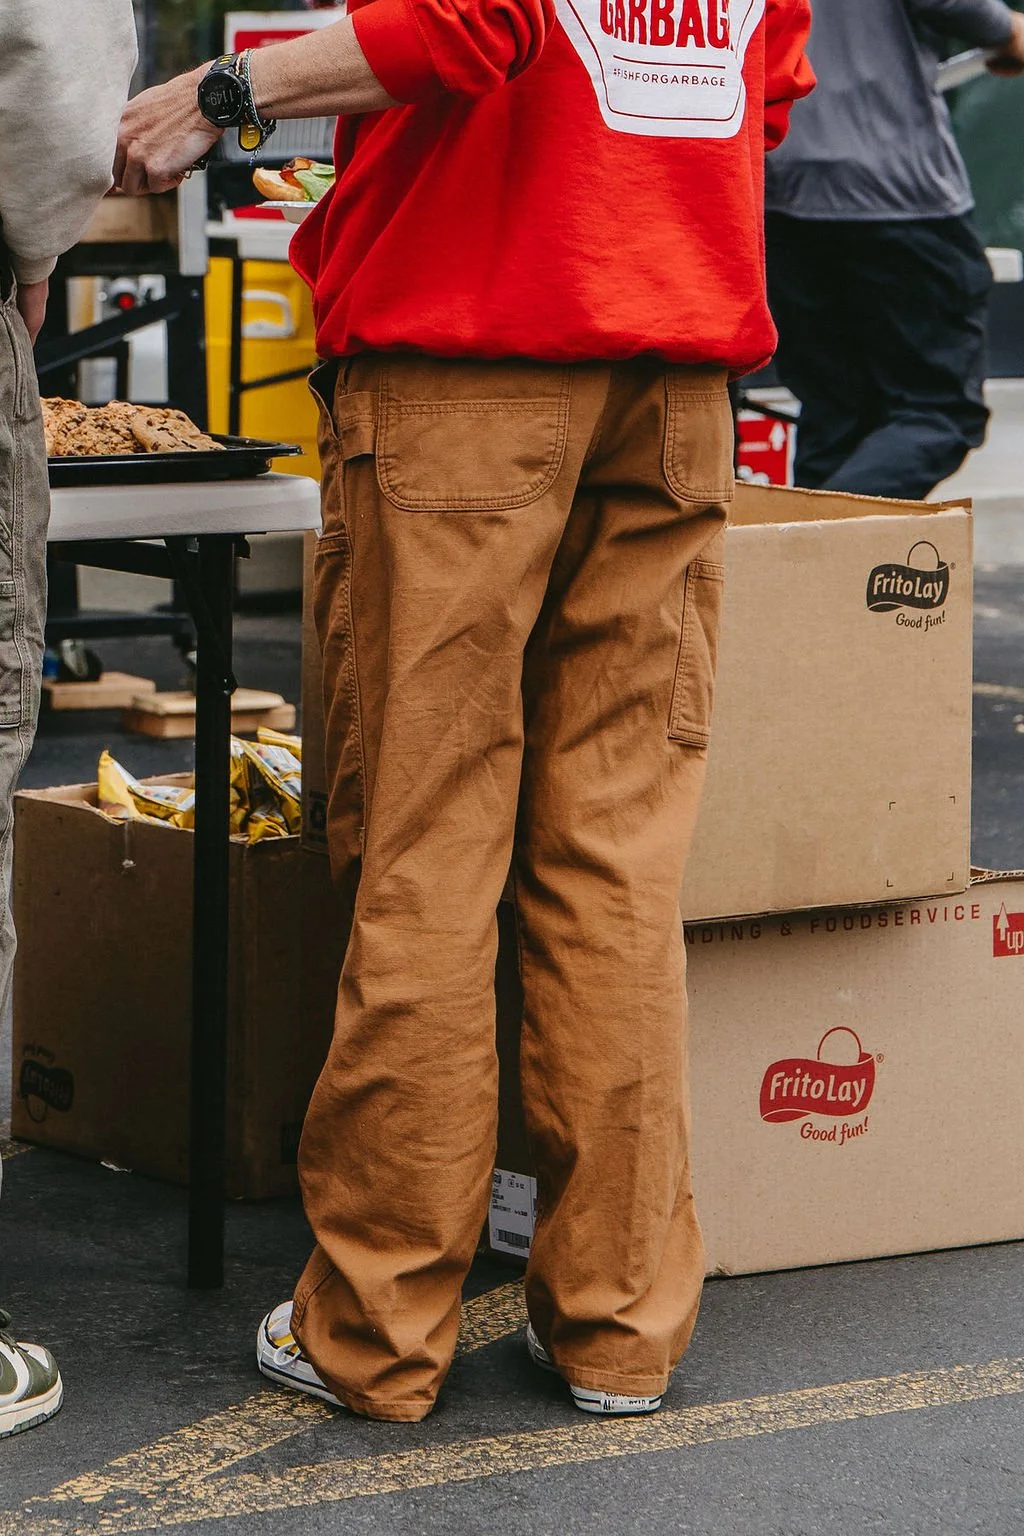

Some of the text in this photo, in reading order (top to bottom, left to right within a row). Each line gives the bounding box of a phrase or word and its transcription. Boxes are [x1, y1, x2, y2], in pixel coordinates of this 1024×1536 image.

[896, 610, 946, 632] Good fun!
[780, 921, 793, 936] &
[810, 903, 981, 934] FOODSERVICE
[1007, 930, 1024, 954] up
[800, 1116, 869, 1146] Good fun!
